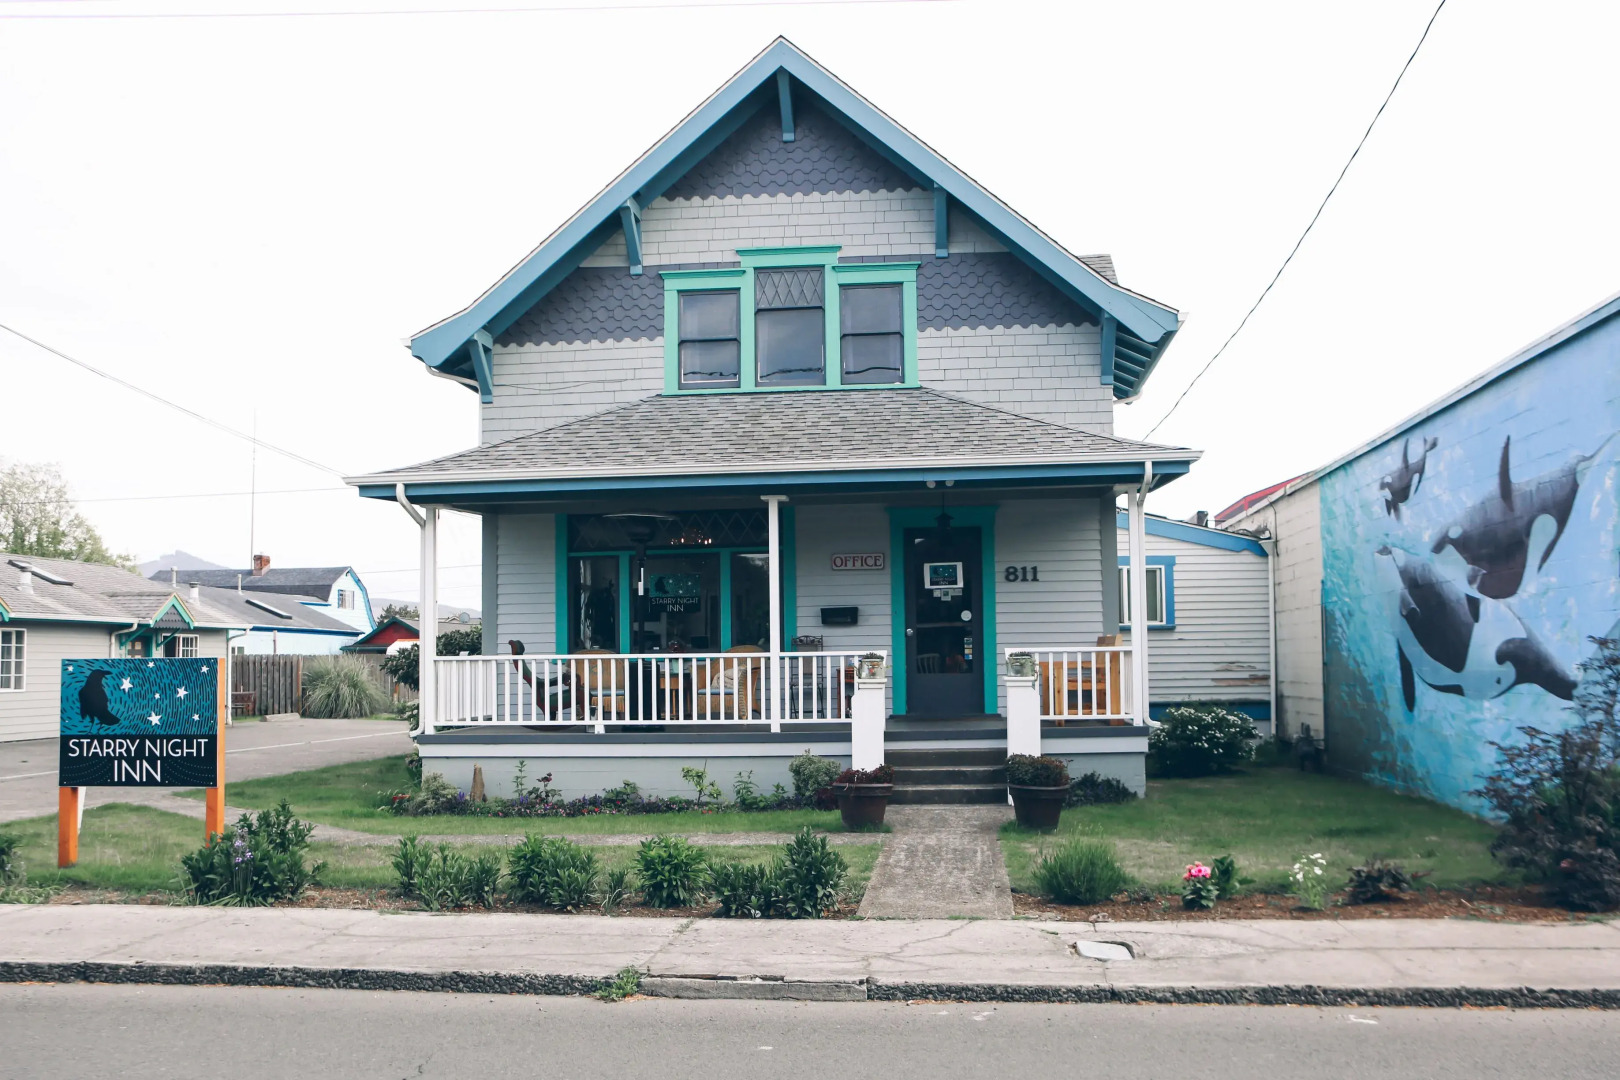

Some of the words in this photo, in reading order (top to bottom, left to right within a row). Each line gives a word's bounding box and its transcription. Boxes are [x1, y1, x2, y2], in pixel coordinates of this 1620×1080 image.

[833, 555, 883, 568] OFFICE
[1005, 566, 1039, 582] 811
[667, 604, 684, 612] INN
[68, 739, 139, 757] STARRY
[145, 739, 208, 757] NIGHT
[114, 759, 161, 782] INN
